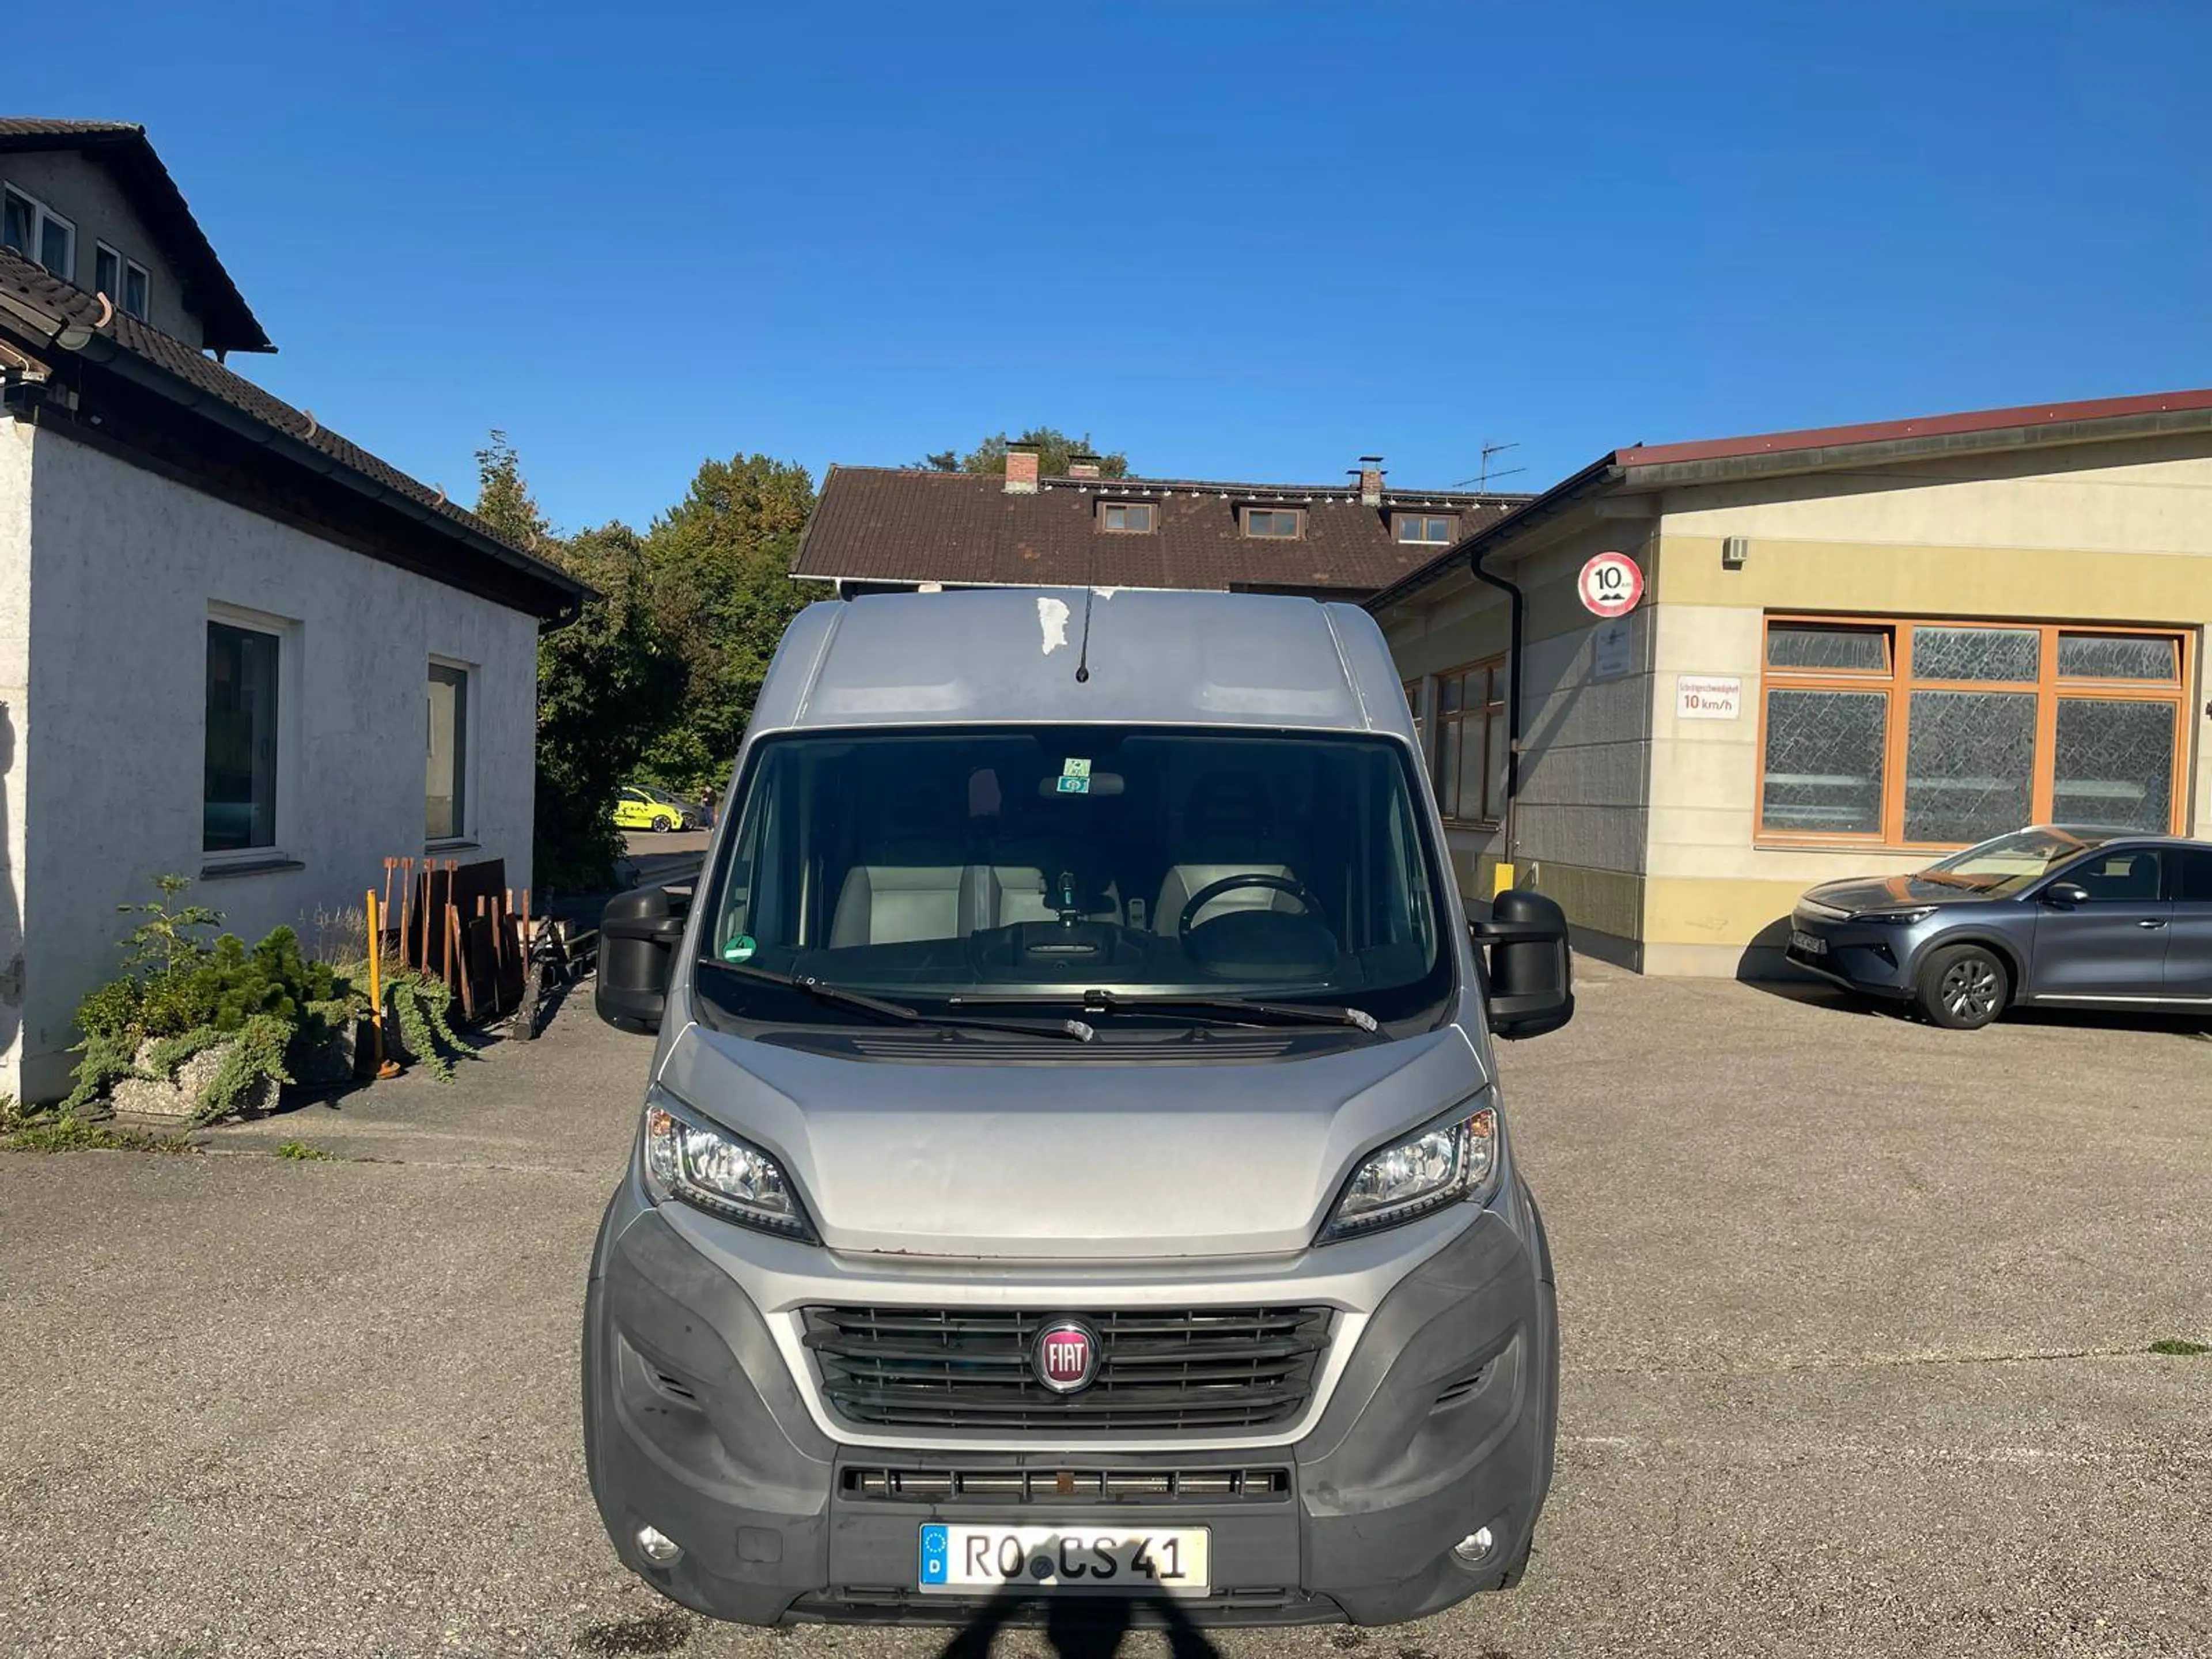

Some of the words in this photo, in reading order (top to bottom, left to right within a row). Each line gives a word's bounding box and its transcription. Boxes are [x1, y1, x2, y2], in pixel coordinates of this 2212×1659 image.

[1594, 567, 1622, 590] 10
[1684, 695, 1699, 709] 10
[1702, 698, 1732, 710] km/h
[735, 936, 745, 949] 4
[1049, 1343, 1084, 1372] FIAT
[929, 1559, 941, 1574] D
[966, 1535, 1025, 1578] RO
[1059, 1537, 1118, 1579] CS
[1131, 1537, 1185, 1579] 41
